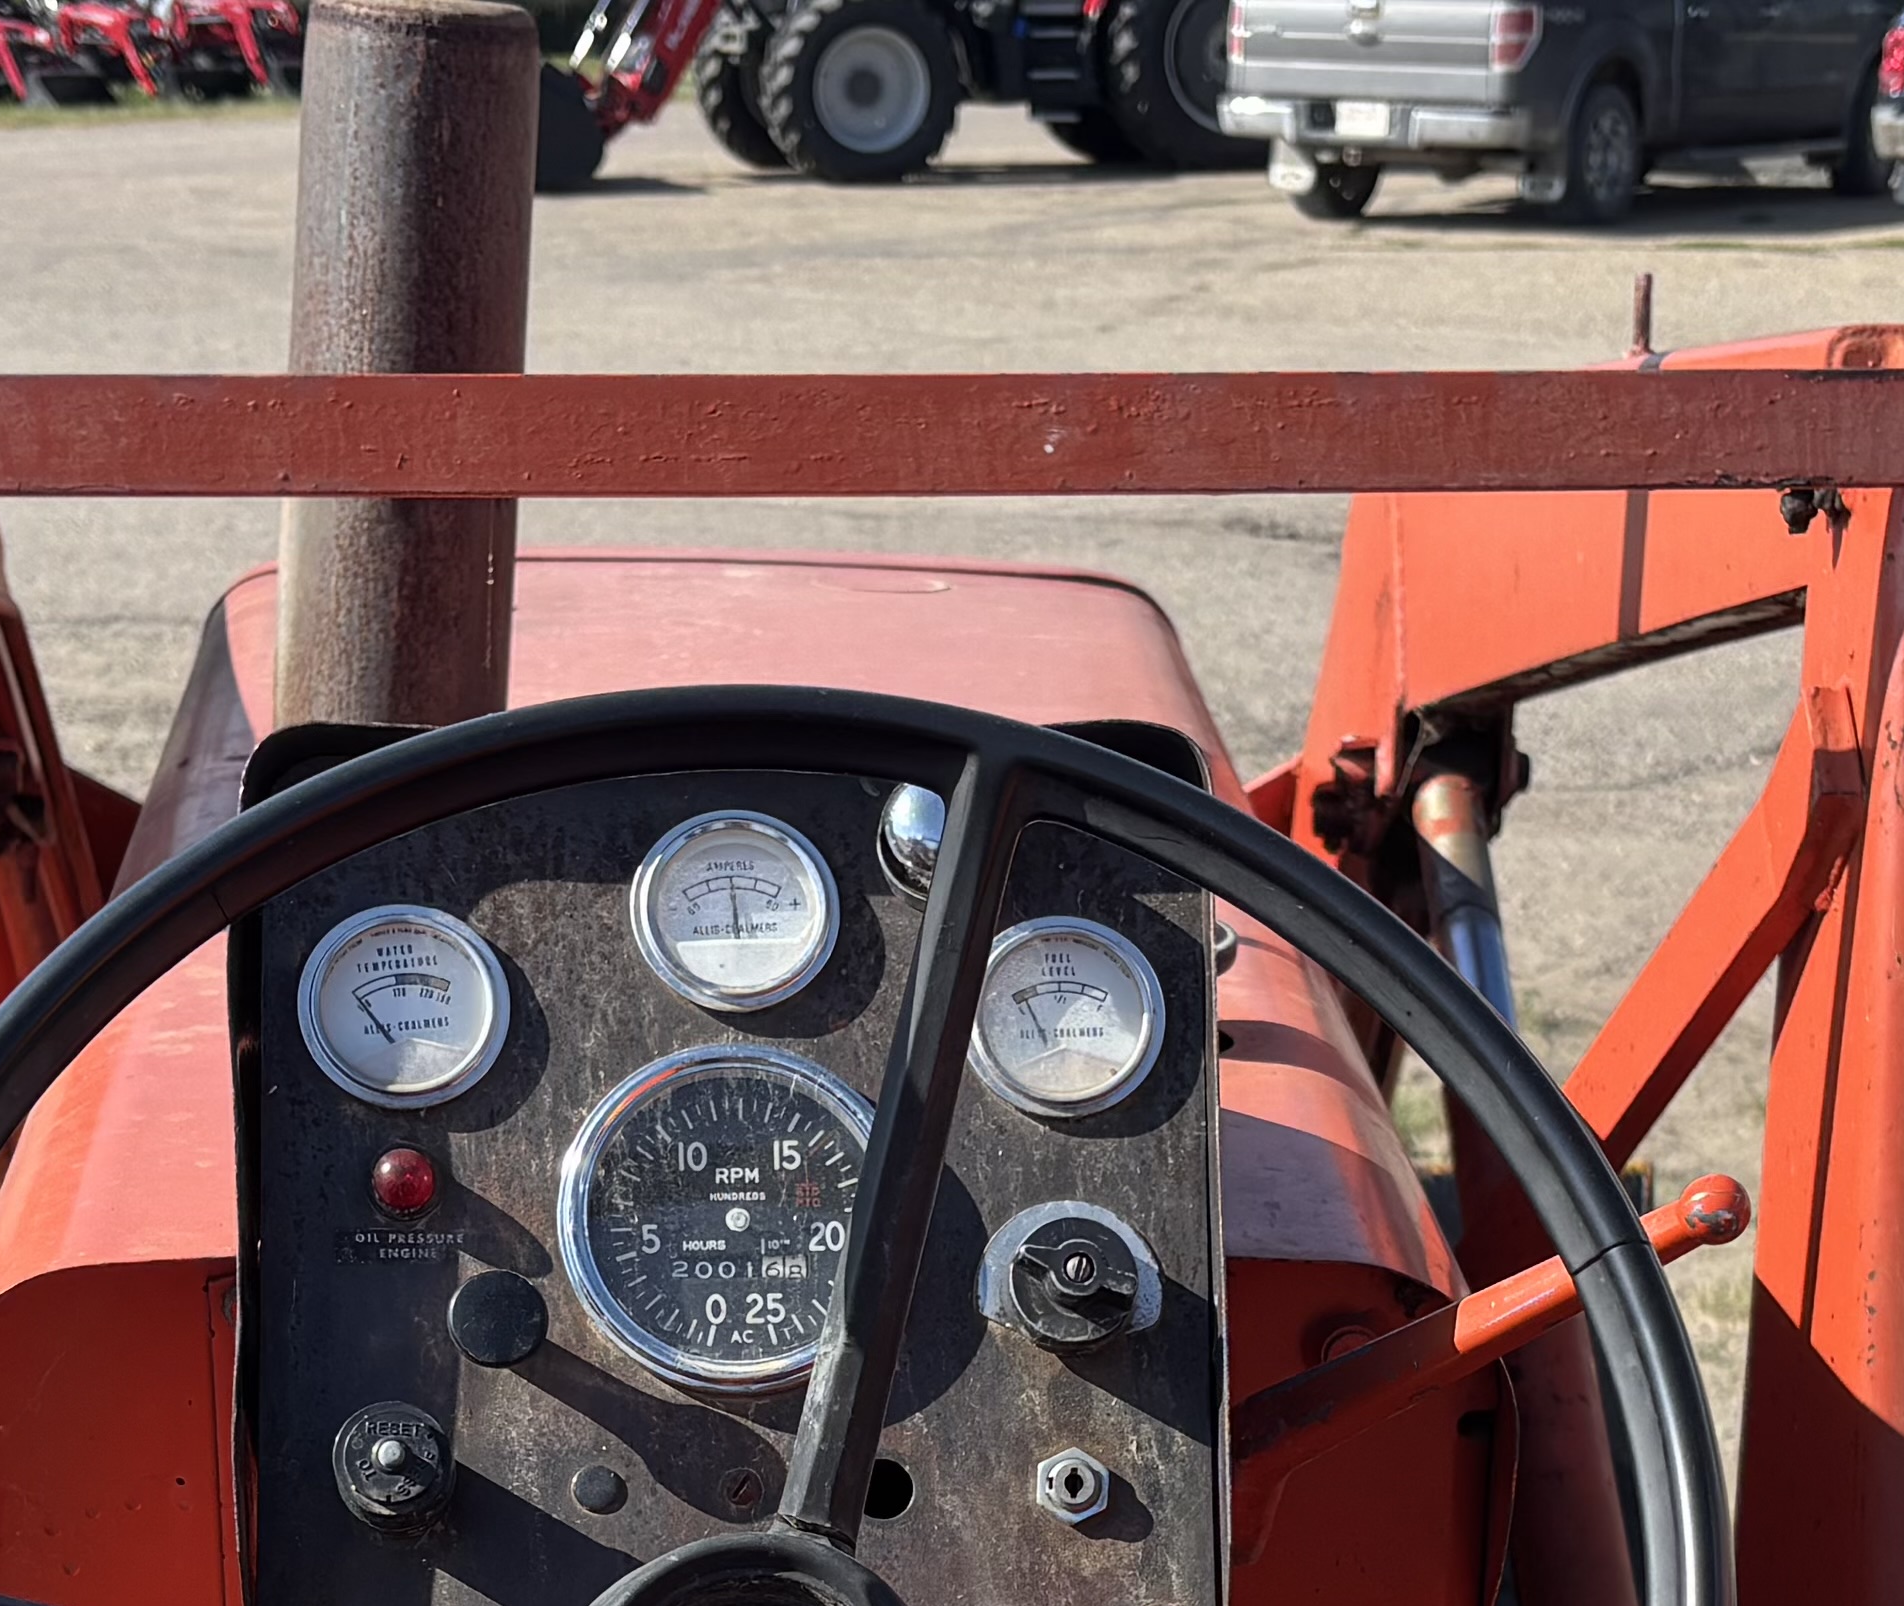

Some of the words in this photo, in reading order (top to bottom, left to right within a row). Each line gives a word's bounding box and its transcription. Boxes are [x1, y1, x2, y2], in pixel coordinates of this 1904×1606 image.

[1045, 953, 1071, 963] FUEL
[1041, 966, 1076, 977] LEVEL
[678, 1141, 708, 1172] 10
[773, 1140, 801, 1171] 15
[715, 1167, 760, 1183] RPM
[709, 1192, 766, 1201] HUNDREDS
[354, 1233, 380, 1244] OIL
[388, 1232, 465, 1245] PRESSURE
[641, 1224, 661, 1254] 5
[809, 1221, 846, 1251] 20
[682, 1239, 727, 1251] HOURS
[379, 1248, 438, 1259] ENGINE
[706, 1293, 728, 1324] 0
[745, 1292, 787, 1324] 25
[730, 1330, 754, 1344] AC
[365, 1421, 422, 1437] RESET
